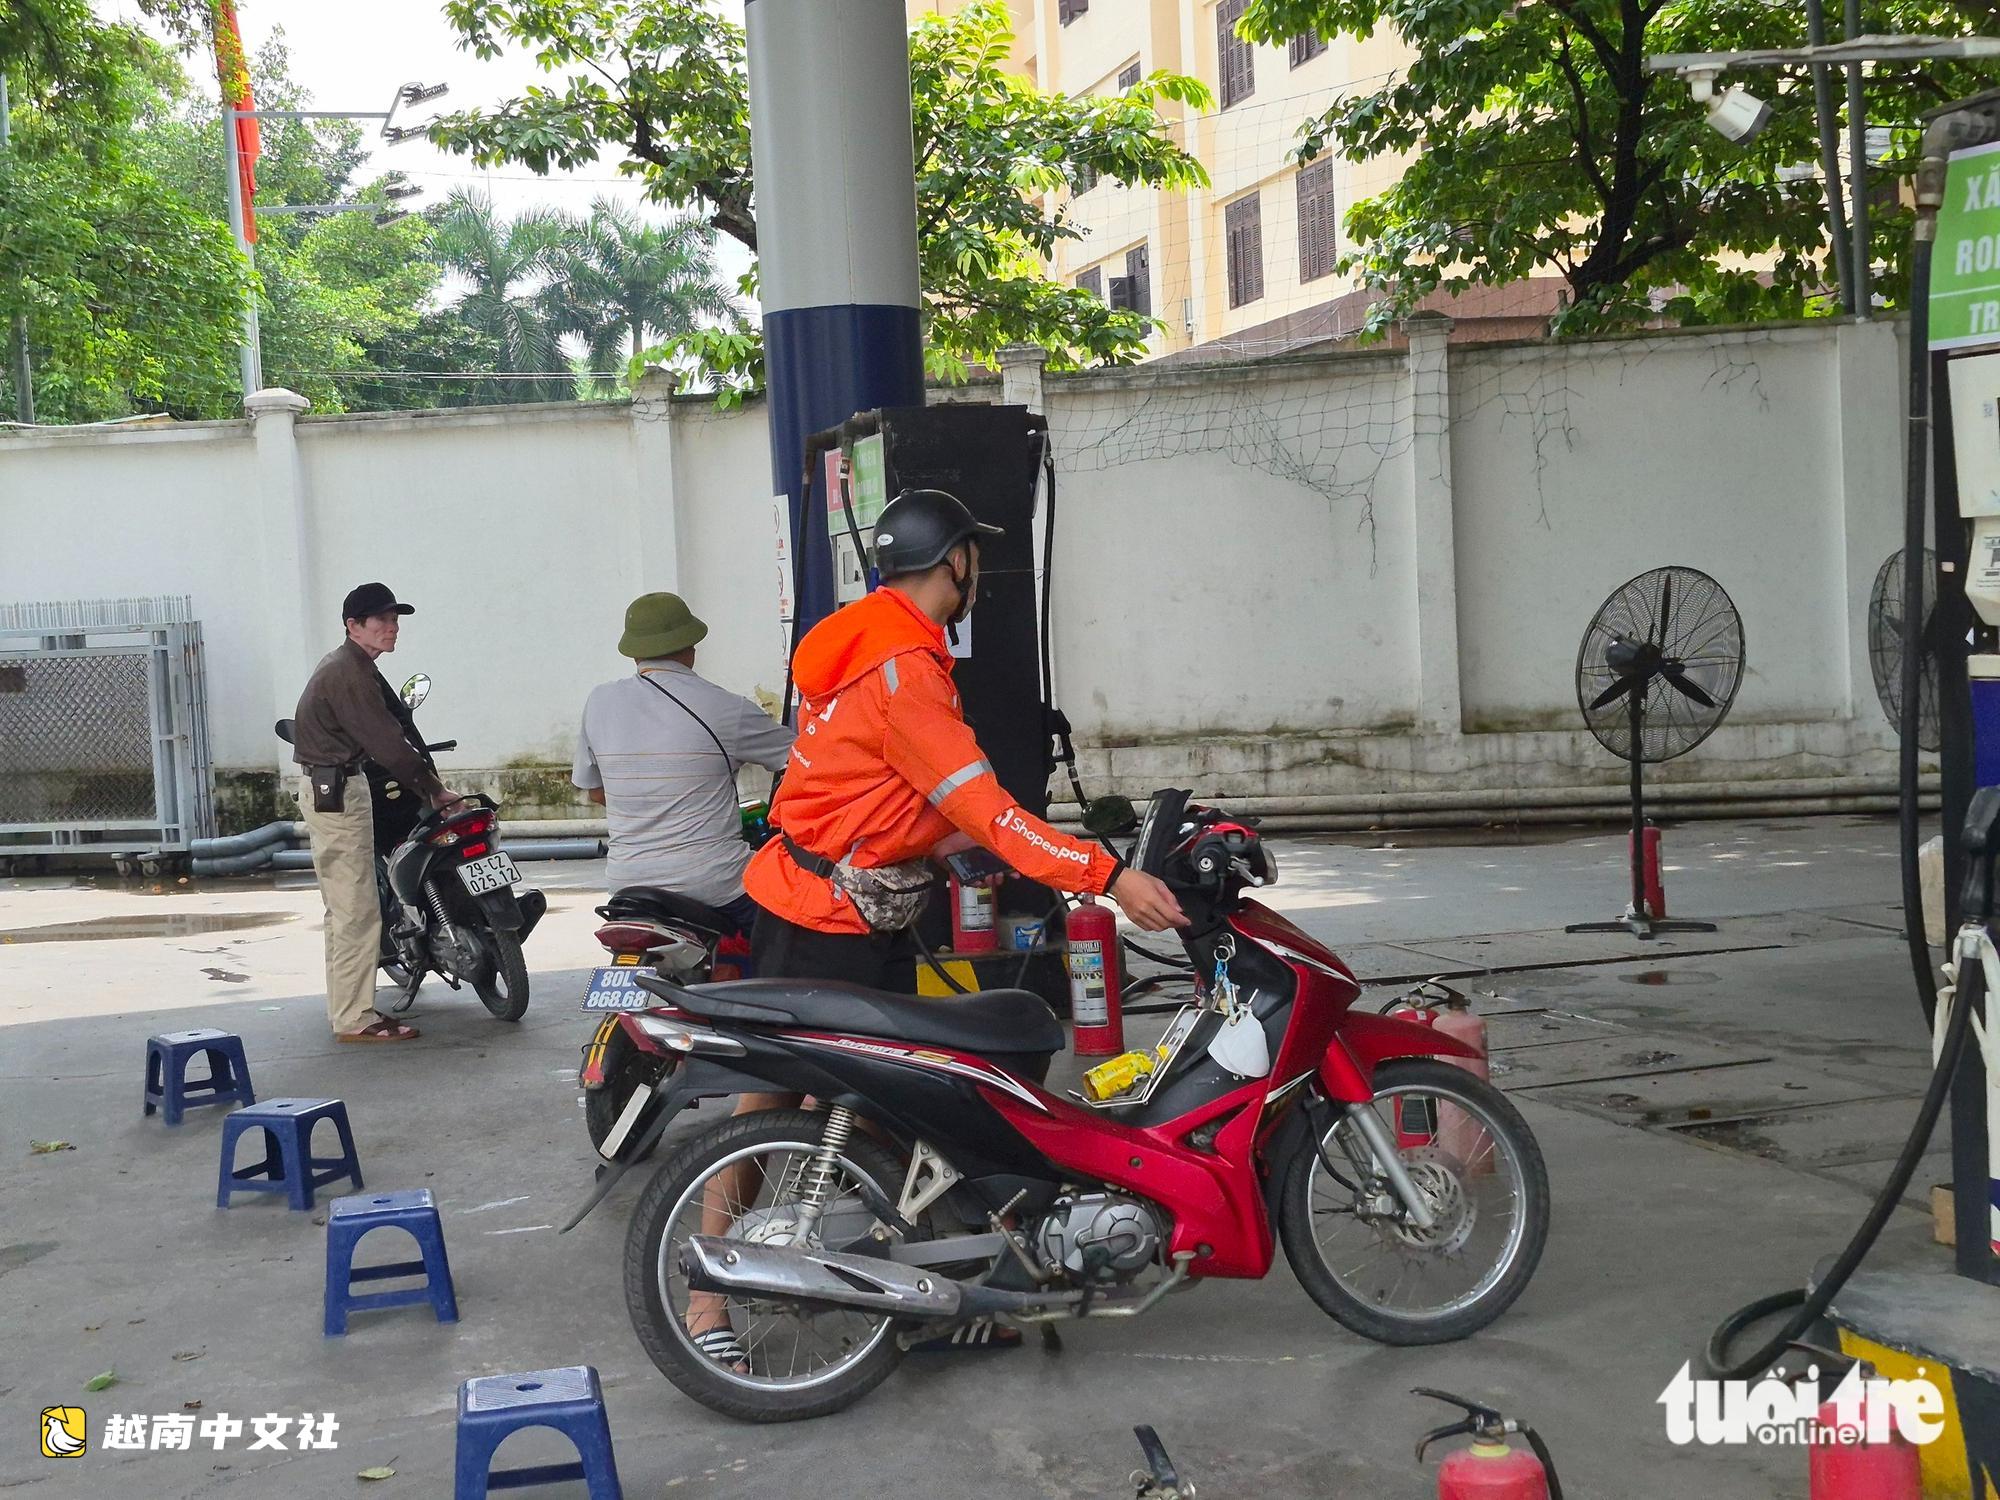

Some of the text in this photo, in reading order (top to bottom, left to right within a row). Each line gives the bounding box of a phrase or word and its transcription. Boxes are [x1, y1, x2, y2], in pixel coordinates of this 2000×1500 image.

[466, 855, 505, 878] 29-C2
[470, 868, 518, 893] 025.12
[587, 990, 647, 1008] 868.68
